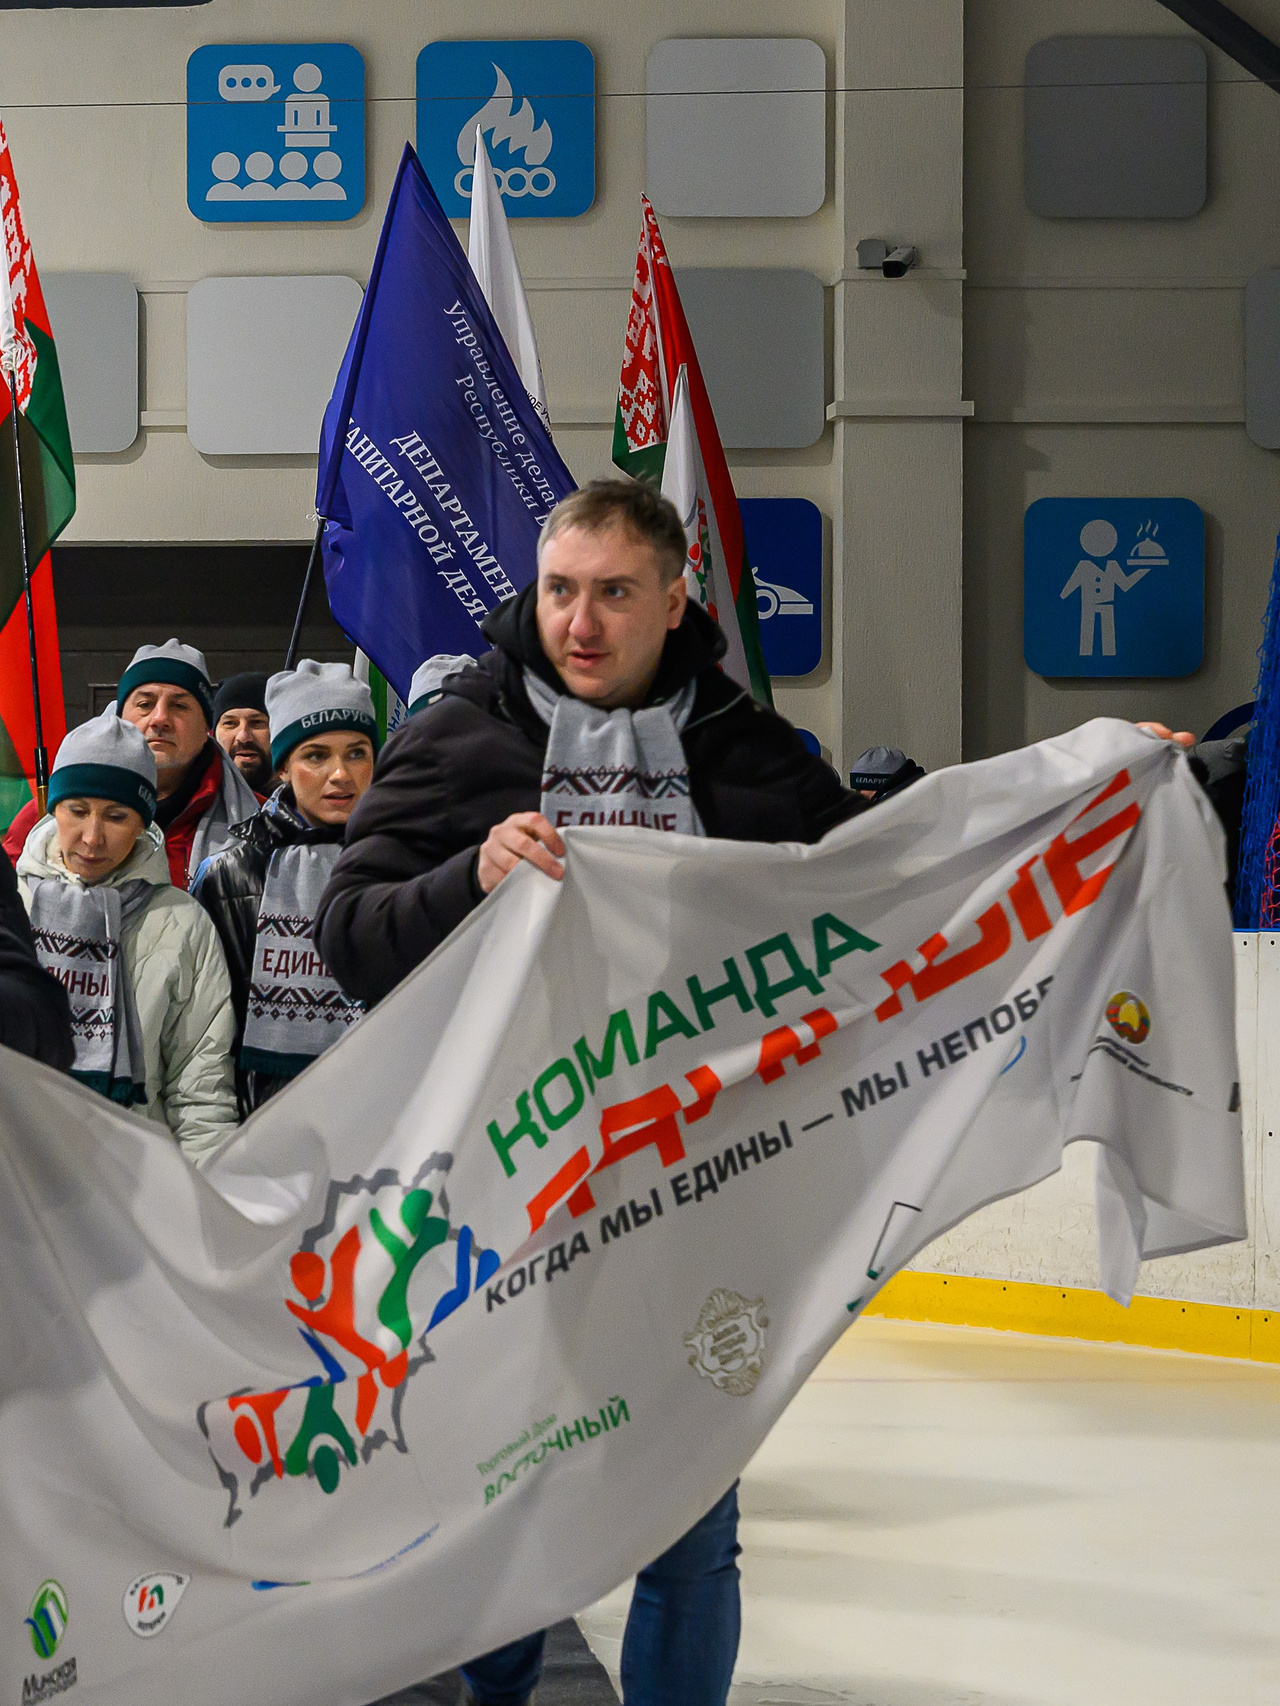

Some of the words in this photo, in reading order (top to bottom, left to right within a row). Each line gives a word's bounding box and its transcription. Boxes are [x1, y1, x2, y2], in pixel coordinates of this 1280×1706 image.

[444, 300, 526, 447] Управление
[456, 373, 539, 509] Республики
[345, 417, 456, 565] АНИТАРНОЙ
[389, 430, 518, 603] ДЕПАРТАМЕН
[486, 912, 882, 1178] КОМАНДА
[486, 1231, 590, 1313] КОГДА
[600, 1188, 664, 1244] МЫ
[670, 1121, 793, 1206] ЕДИНЫ
[841, 1061, 909, 1117] МЫ
